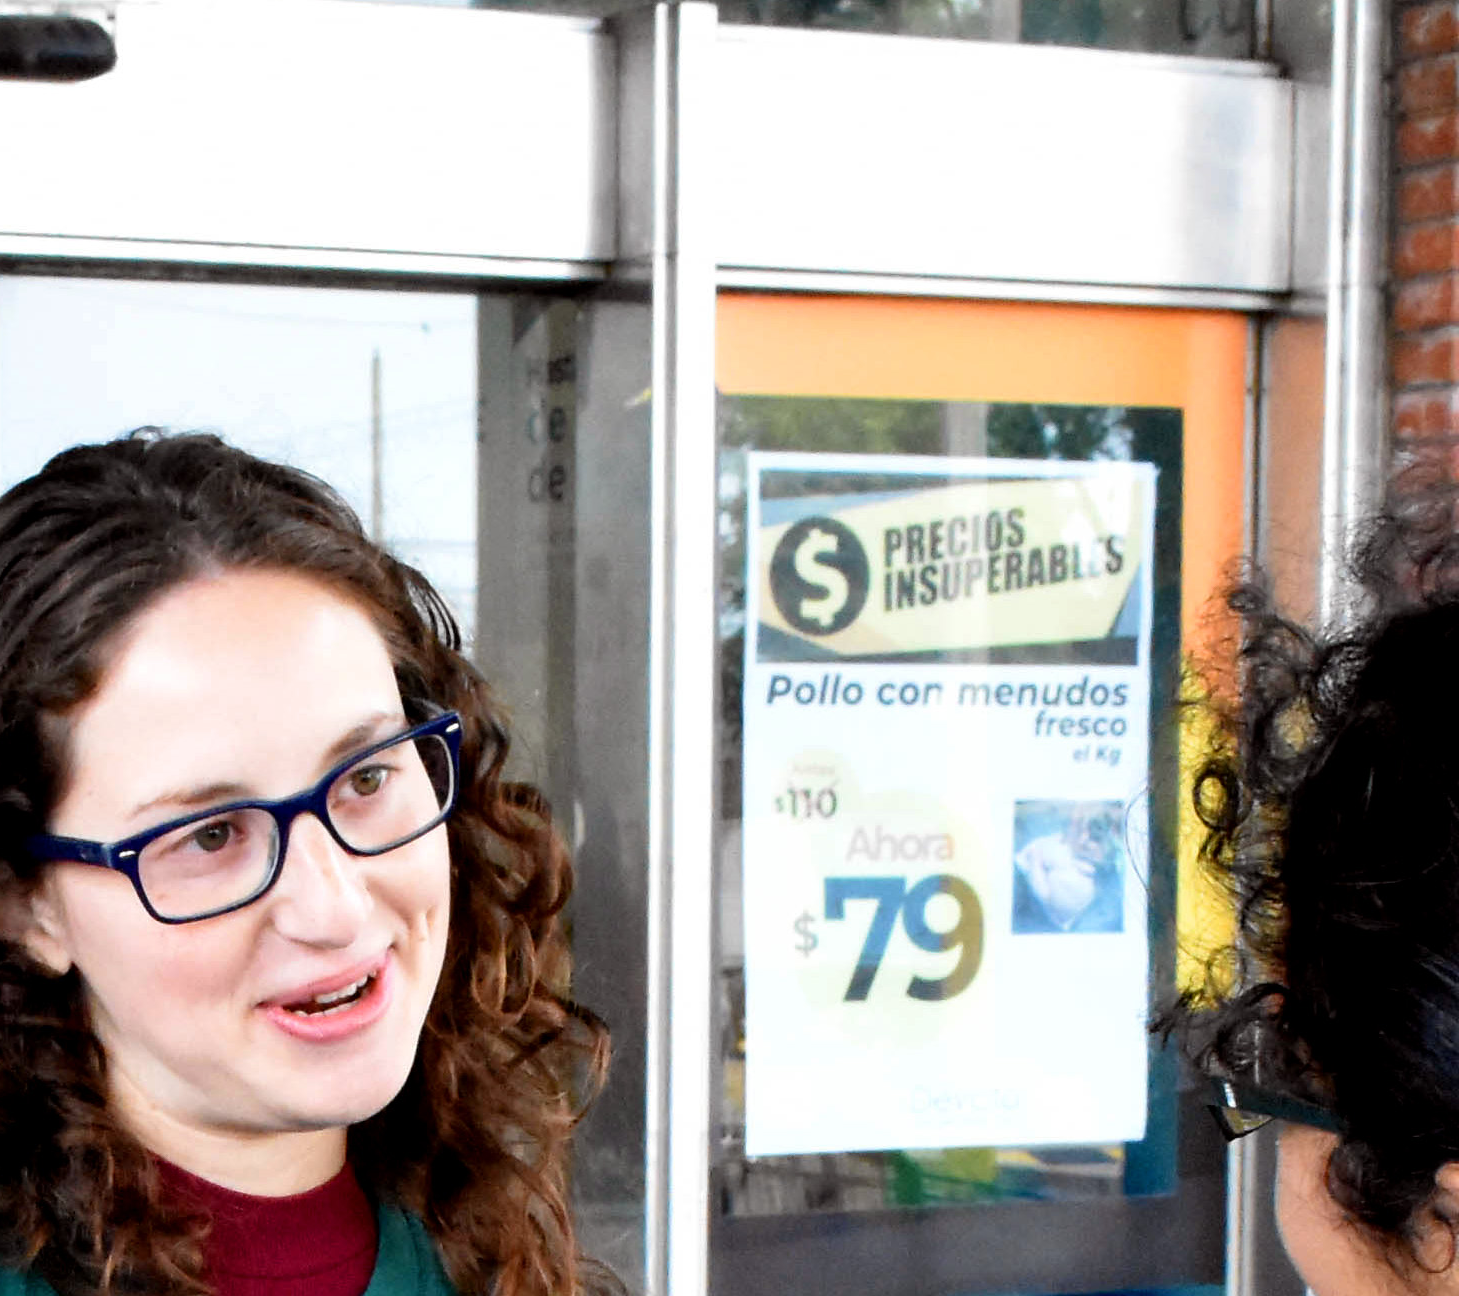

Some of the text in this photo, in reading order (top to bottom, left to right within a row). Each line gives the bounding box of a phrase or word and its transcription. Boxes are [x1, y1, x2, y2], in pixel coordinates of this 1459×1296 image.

[884, 507, 1026, 568] PRECIOS
[766, 673, 1129, 706] Pollo con menudos
[1034, 710, 1128, 738] fresco
[845, 826, 956, 862] Ahora
